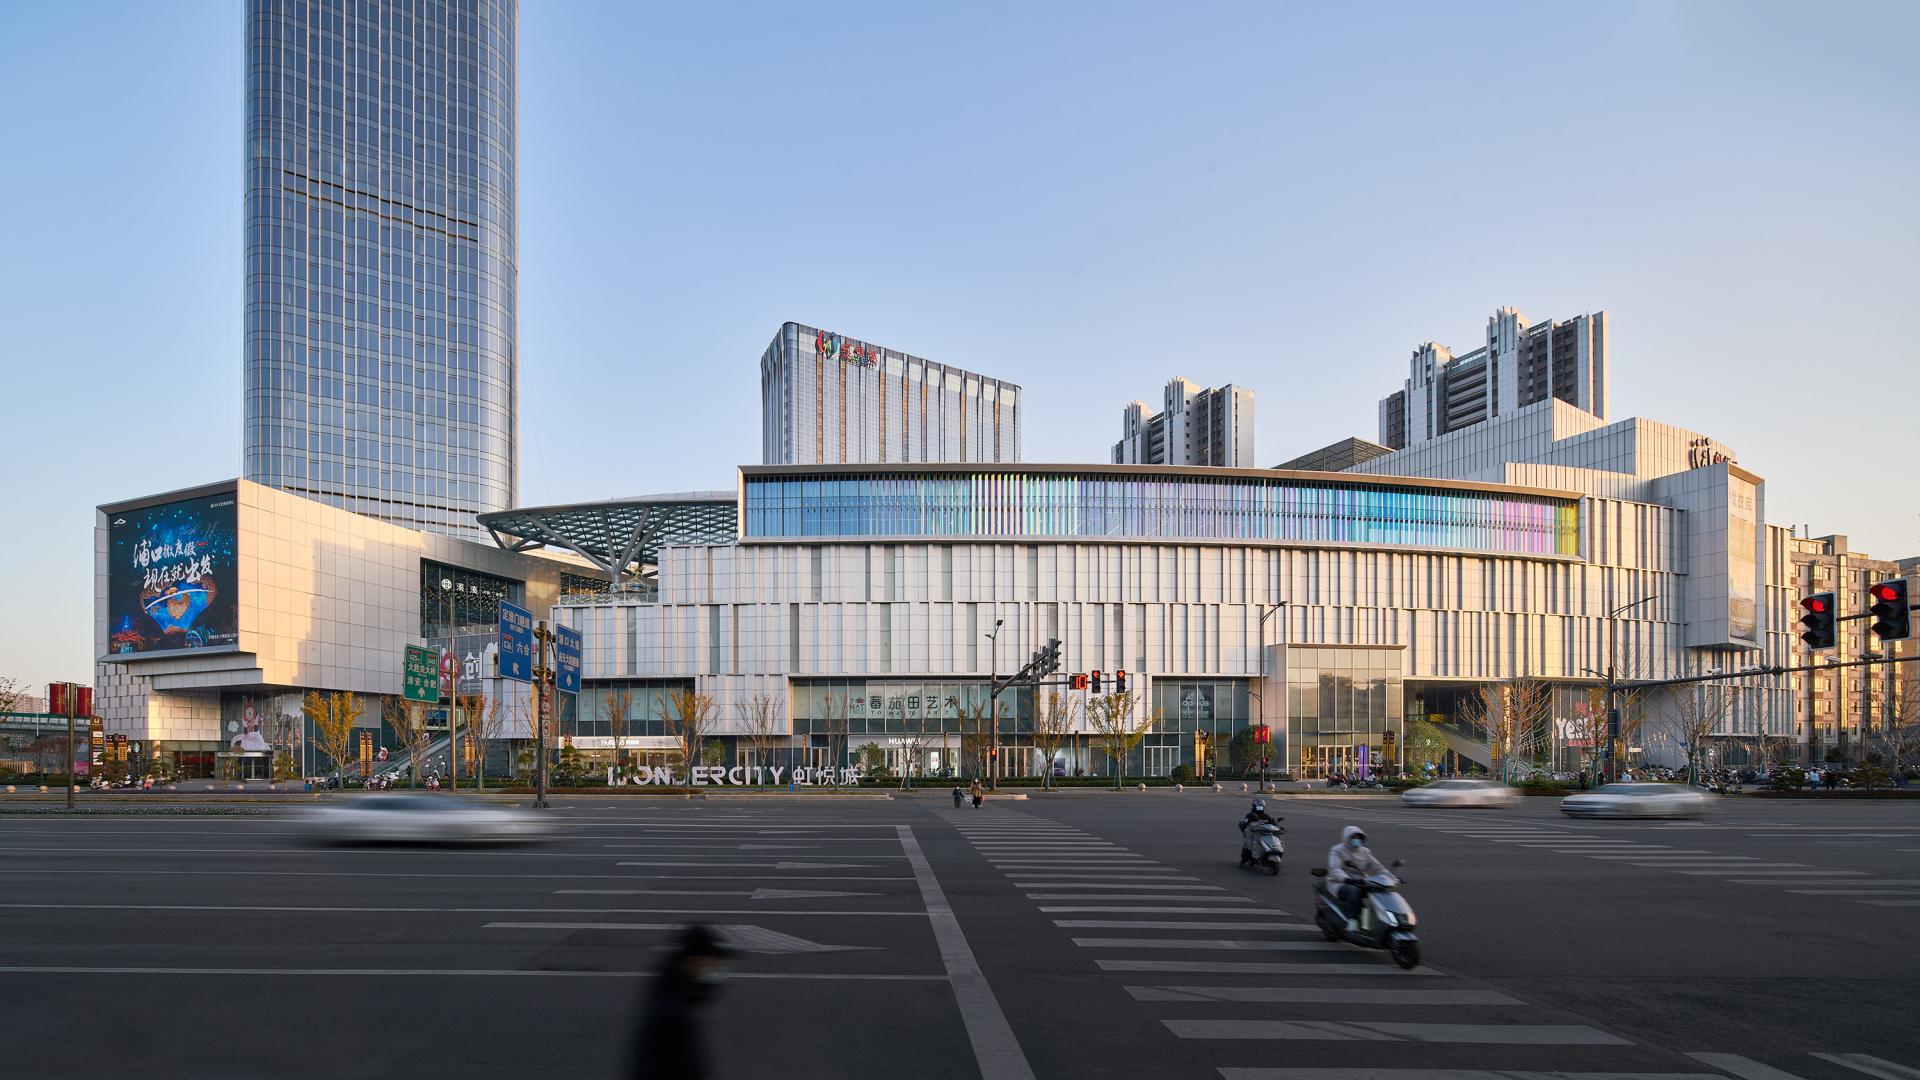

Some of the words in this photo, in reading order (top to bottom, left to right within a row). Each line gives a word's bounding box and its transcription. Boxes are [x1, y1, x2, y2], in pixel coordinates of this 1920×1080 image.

[143, 554, 216, 593] 现在就出发
[516, 641, 530, 656] 六合
[869, 695, 958, 710] 蕃茄田艺术
[793, 765, 859, 786] 虹悦城
